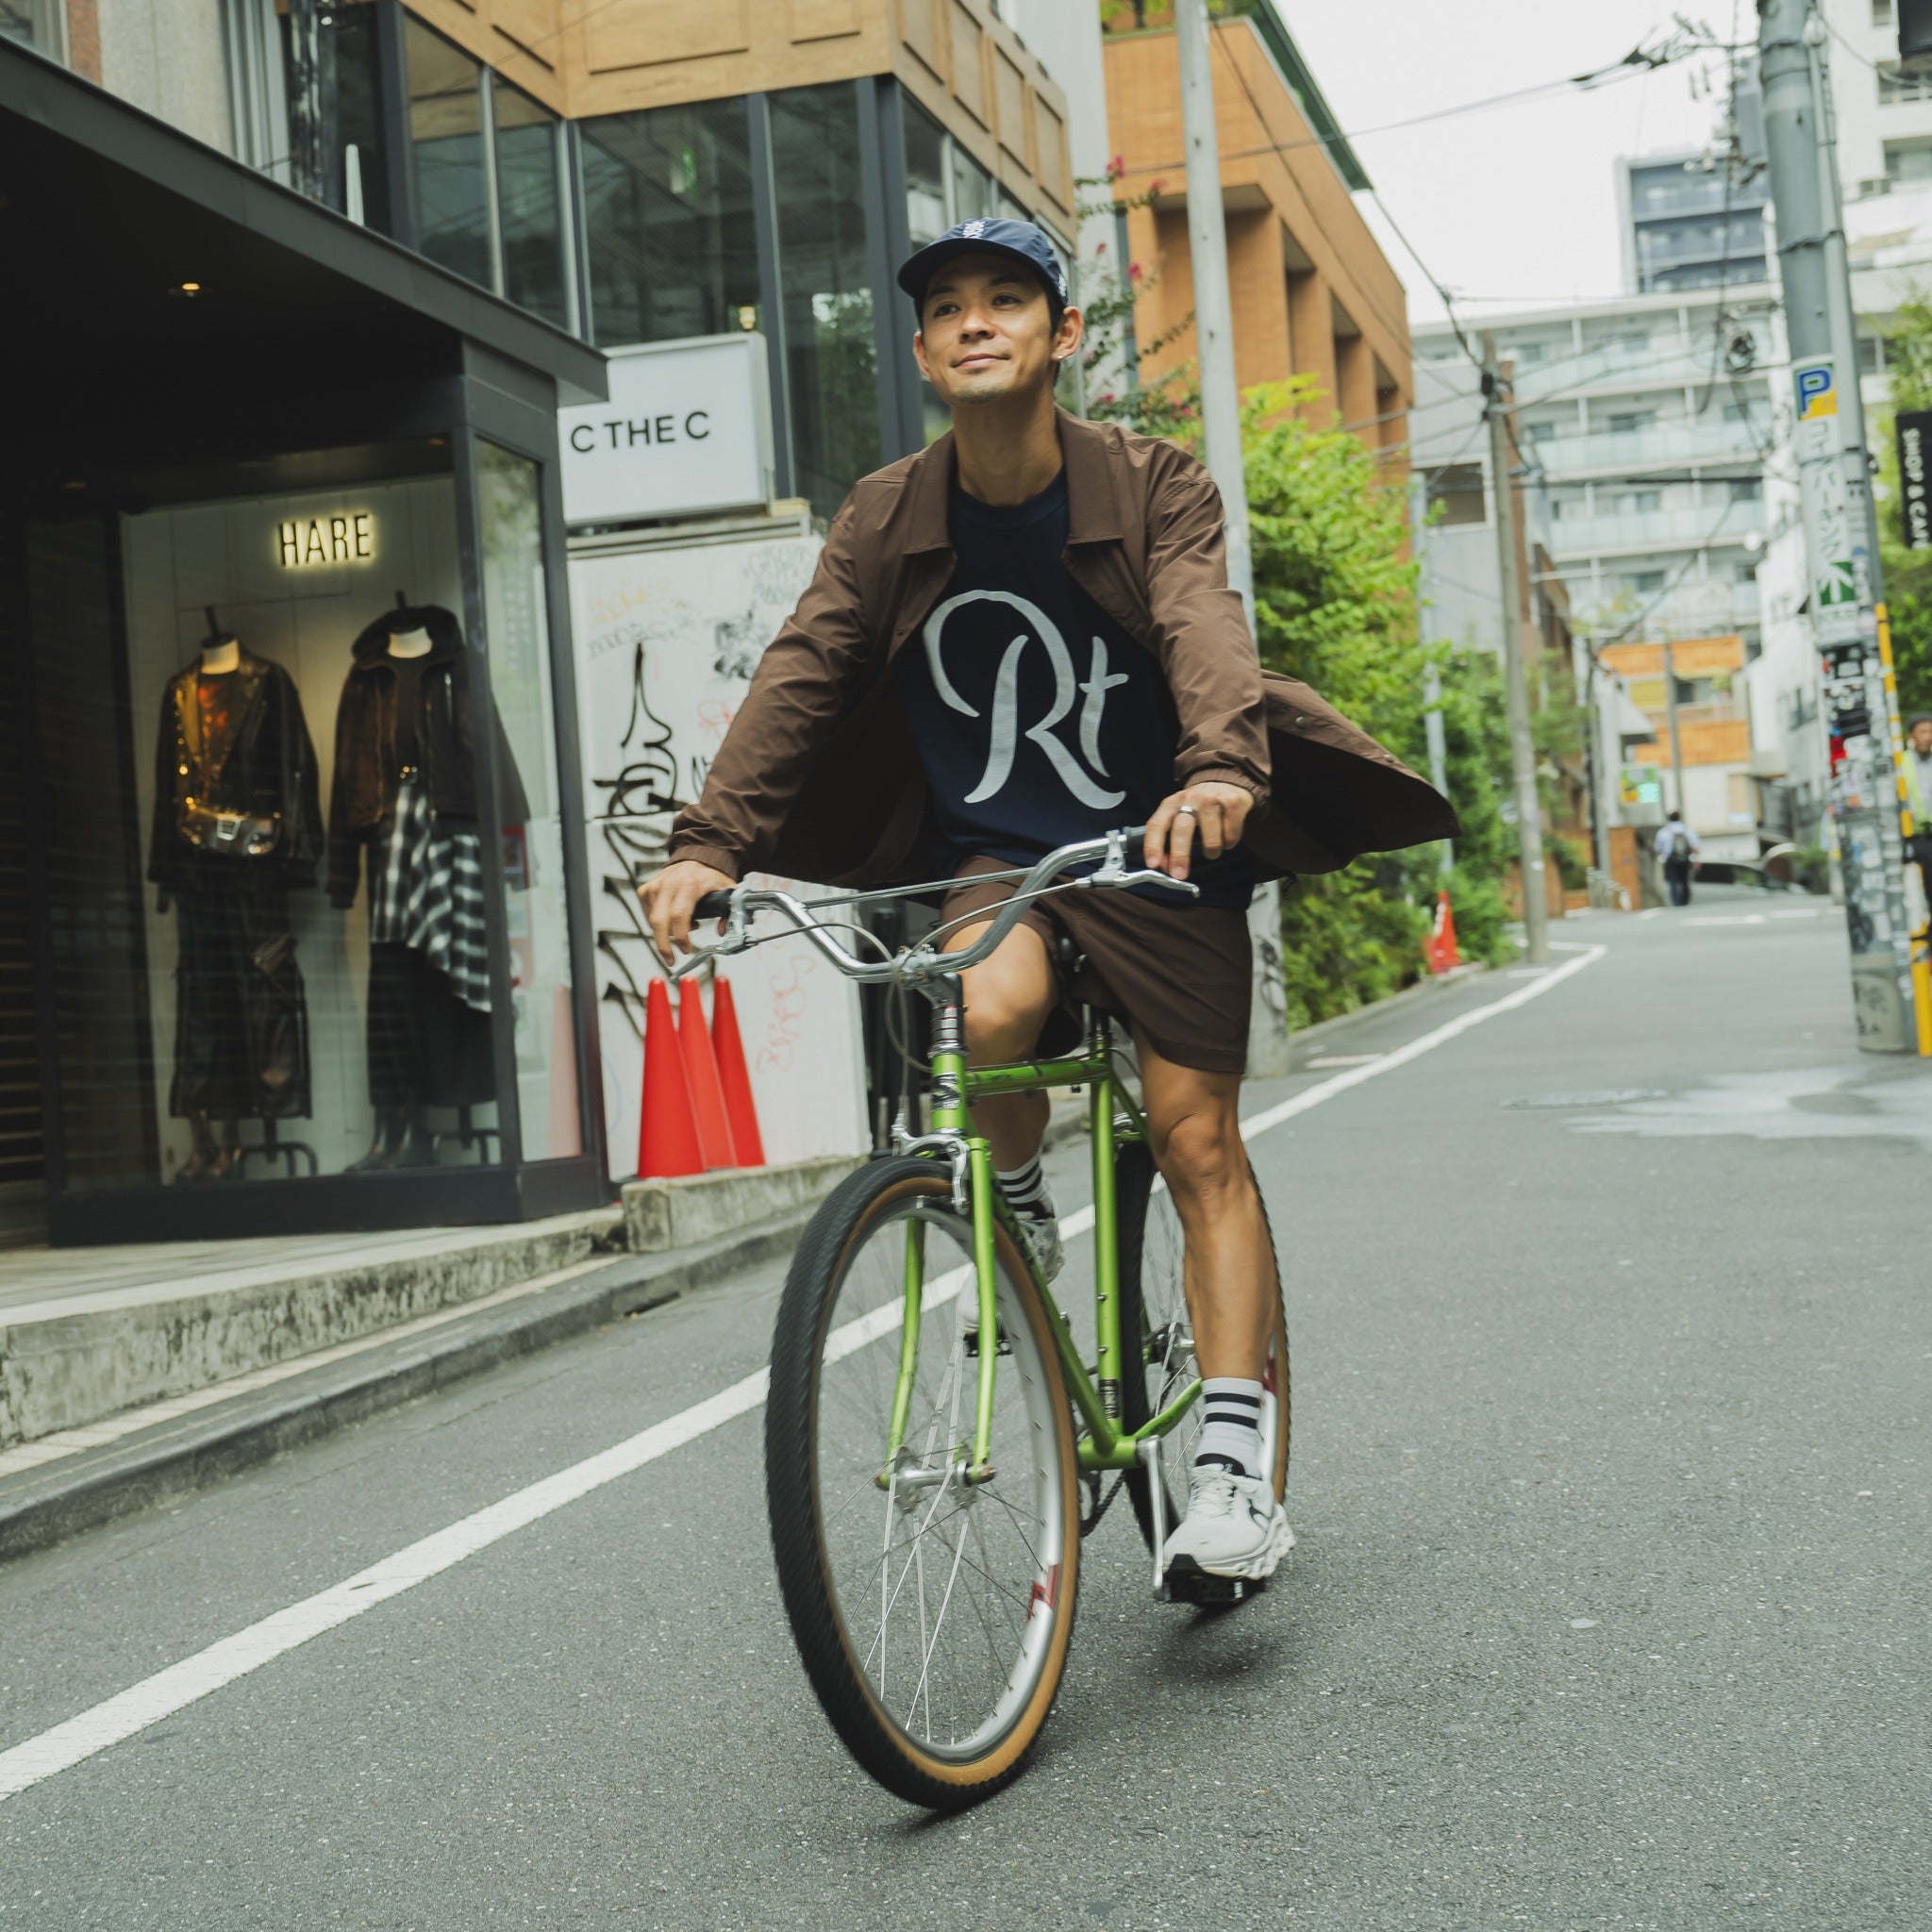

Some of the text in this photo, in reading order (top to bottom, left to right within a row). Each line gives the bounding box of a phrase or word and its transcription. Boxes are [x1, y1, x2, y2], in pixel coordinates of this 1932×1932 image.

[1798, 369, 1830, 413] P
[570, 410, 709, 453] C THE C
[278, 513, 370, 566] HARE
[922, 589, 1129, 809] Rt
